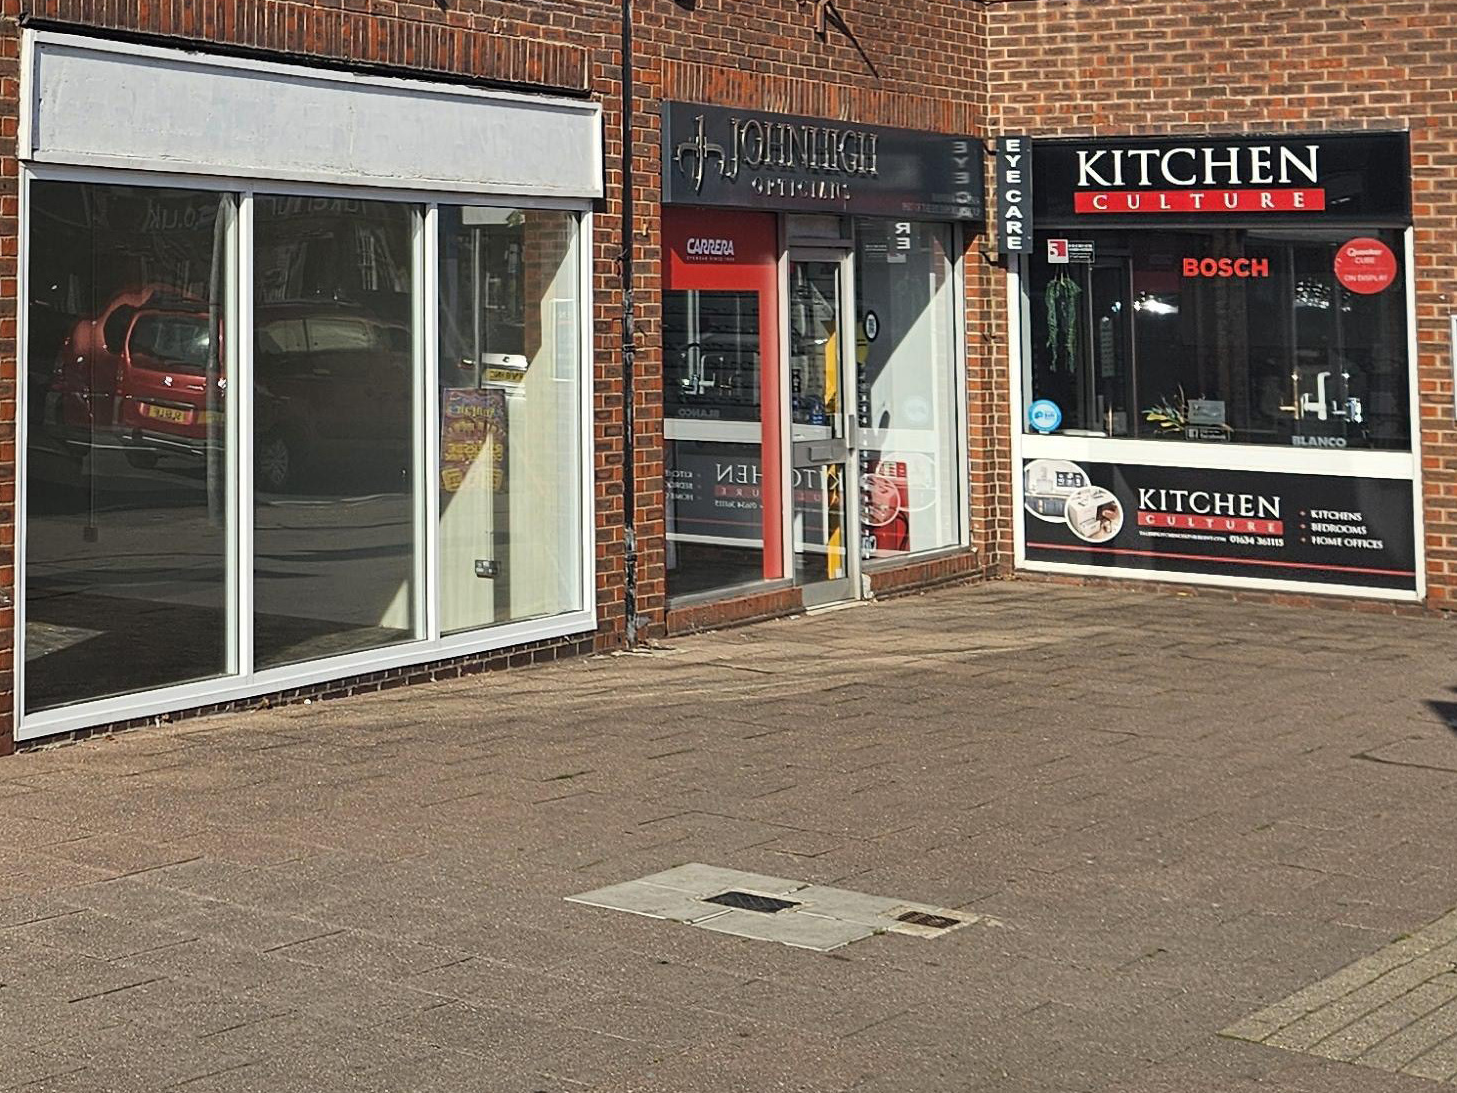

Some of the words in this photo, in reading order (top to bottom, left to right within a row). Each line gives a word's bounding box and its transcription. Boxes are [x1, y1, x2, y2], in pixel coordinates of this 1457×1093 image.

[1005, 139, 1022, 184] EYE
[1075, 144, 1320, 187] KITCHEN
[1092, 192, 1305, 210] CULTURE
[1004, 189, 1024, 250] CARE
[686, 238, 735, 256] CARRERA
[1182, 257, 1269, 278] BOSCH
[1291, 435, 1348, 448] BLANCO
[1137, 487, 1281, 519] KITCHEN
[1145, 515, 1276, 533] CULTURE
[1310, 509, 1363, 522] KITCHENS
[1310, 522, 1367, 535] BEDROOMS
[1229, 534, 1255, 545] 01634
[1310, 535, 1342, 547] HOME
[1343, 537, 1384, 550] OFFICES
